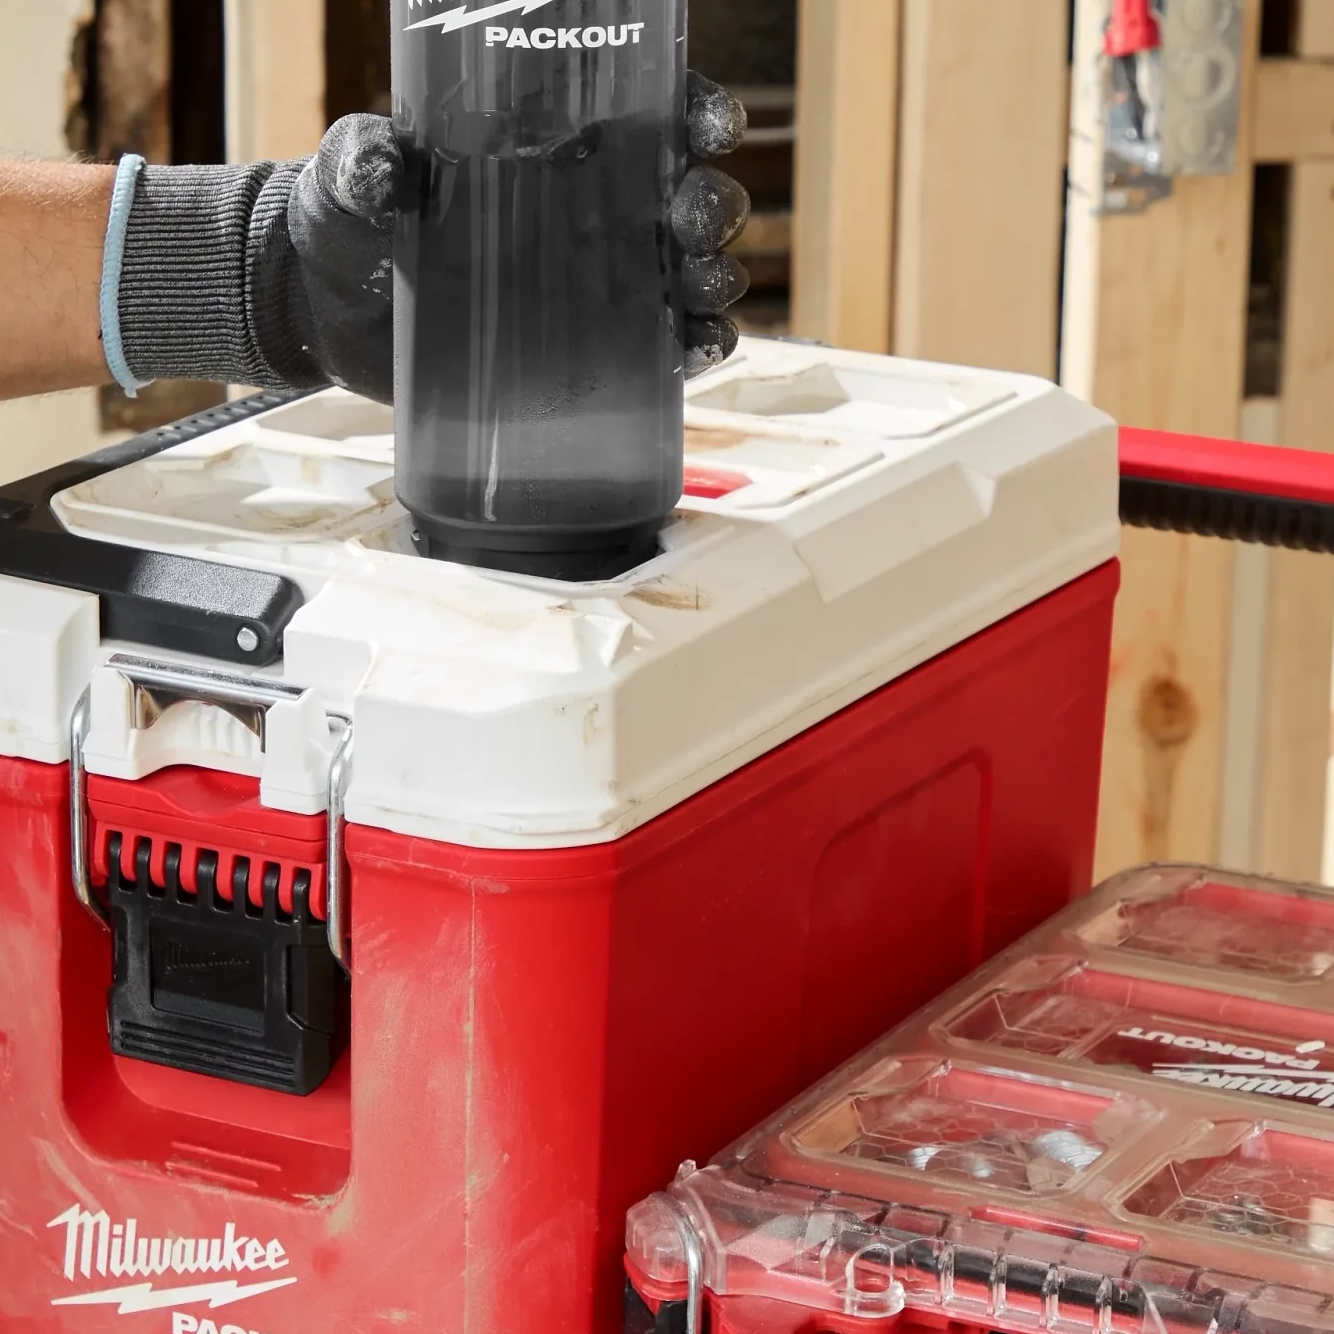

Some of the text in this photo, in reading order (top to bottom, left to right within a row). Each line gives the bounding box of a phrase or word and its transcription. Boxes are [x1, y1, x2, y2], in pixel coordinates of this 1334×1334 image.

[485, 22, 645, 49] PACKOUT
[1117, 1026, 1321, 1071] PACKOUT
[46, 1203, 290, 1282] Milwaukee
